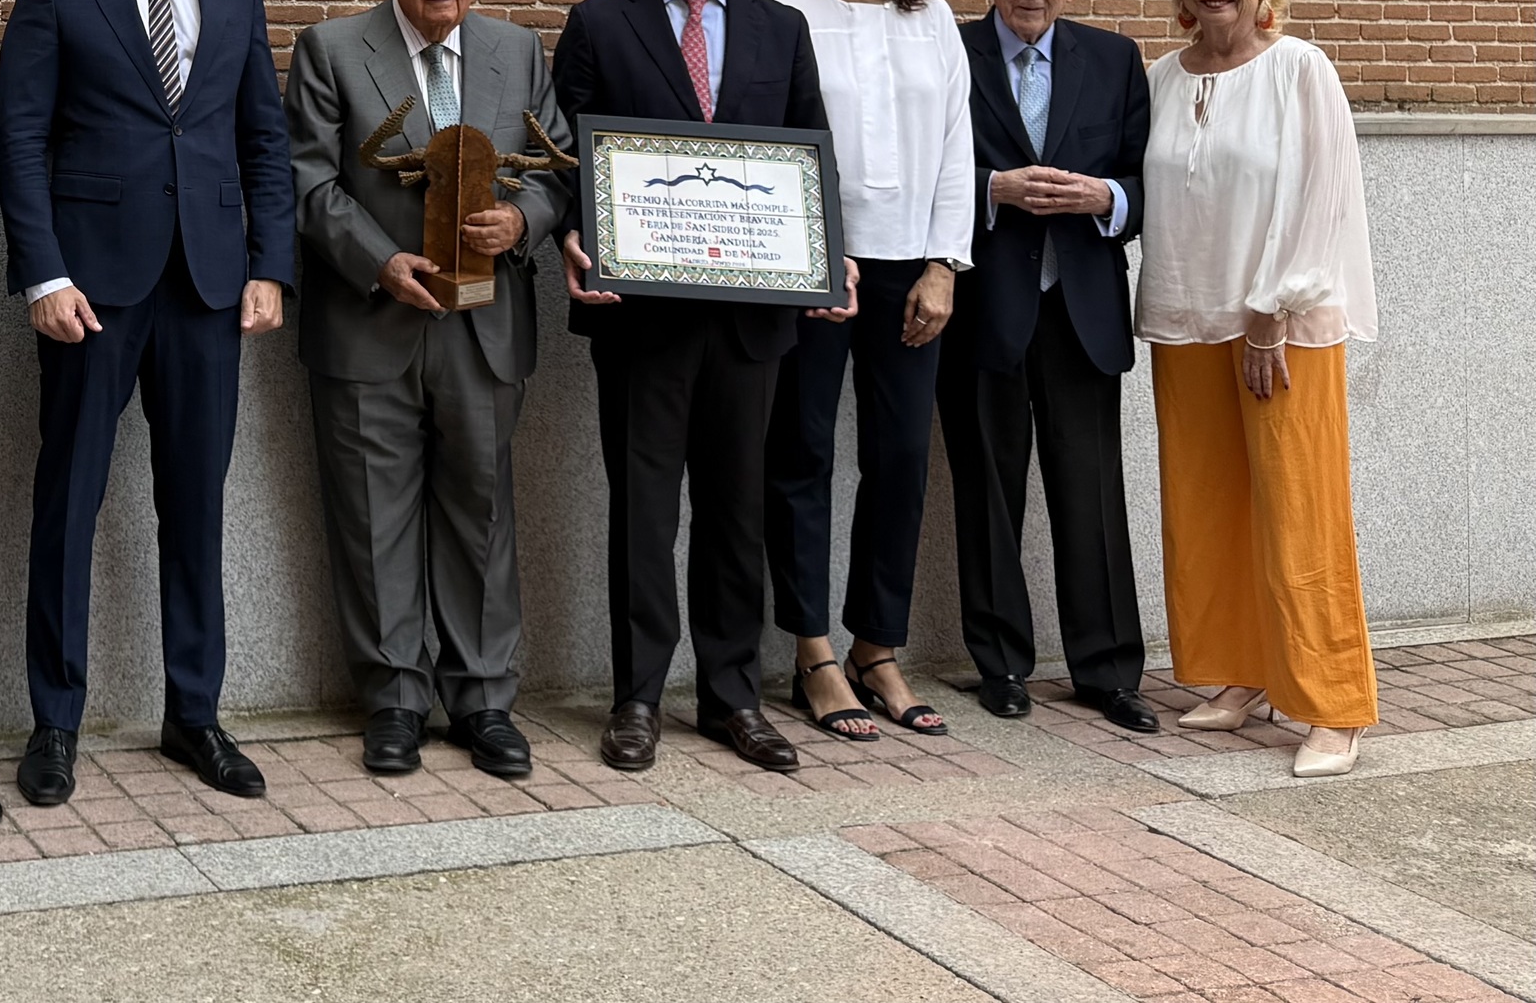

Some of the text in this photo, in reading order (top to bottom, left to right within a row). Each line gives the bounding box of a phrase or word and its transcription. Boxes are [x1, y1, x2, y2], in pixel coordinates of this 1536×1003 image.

[622, 192, 661, 205] PREMIO
[662, 197, 670, 205] A
[685, 198, 728, 209] CORRIDA
[727, 213, 736, 222] Y
[639, 219, 669, 230] FERIA
[670, 222, 683, 231] DE
[684, 221, 707, 232] SAN
[707, 223, 741, 234] ISIDRO
[742, 227, 755, 235] DE
[643, 242, 781, 260] COMUNIDAD DE MADRID
